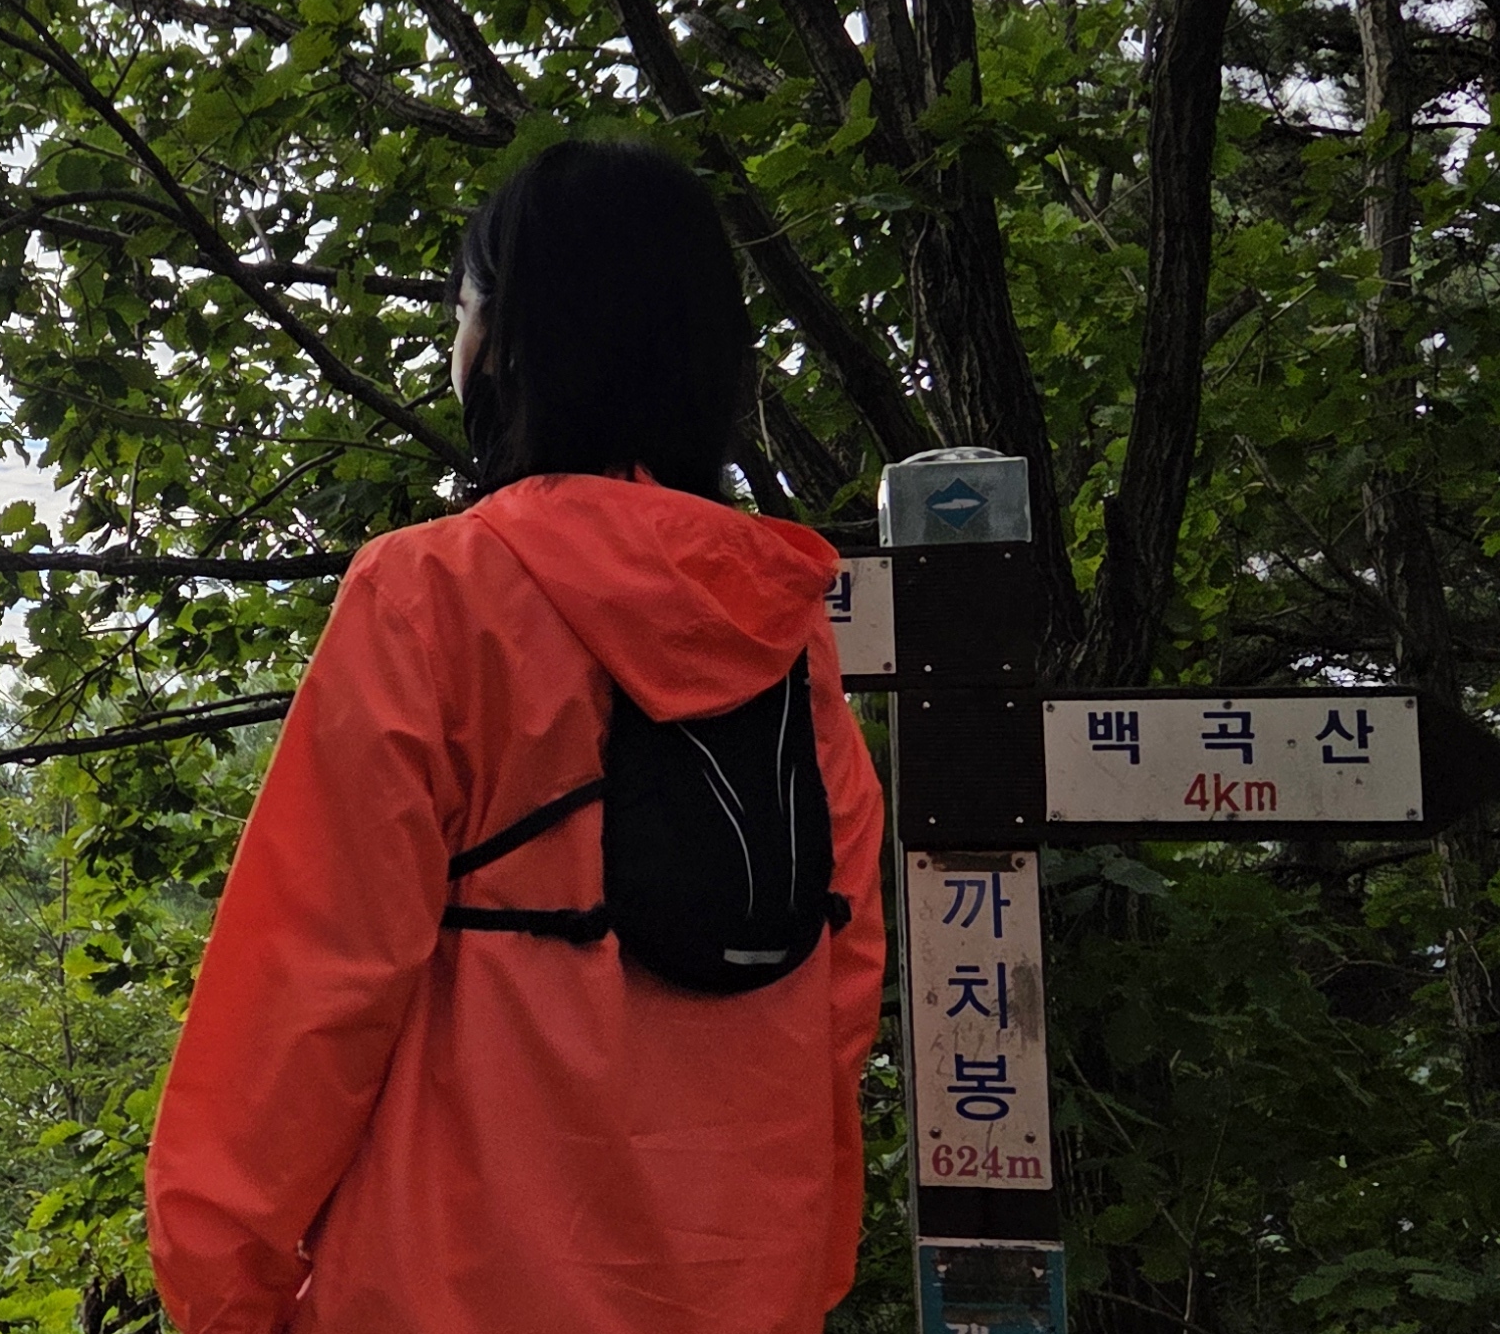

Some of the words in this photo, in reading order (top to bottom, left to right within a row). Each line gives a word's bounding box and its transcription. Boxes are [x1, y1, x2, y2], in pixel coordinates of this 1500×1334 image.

[1087, 709, 1374, 766] 백곡산
[1183, 773, 1278, 813] 4km
[942, 871, 1017, 1121] 까치봉
[931, 1144, 1044, 1180] 624m
